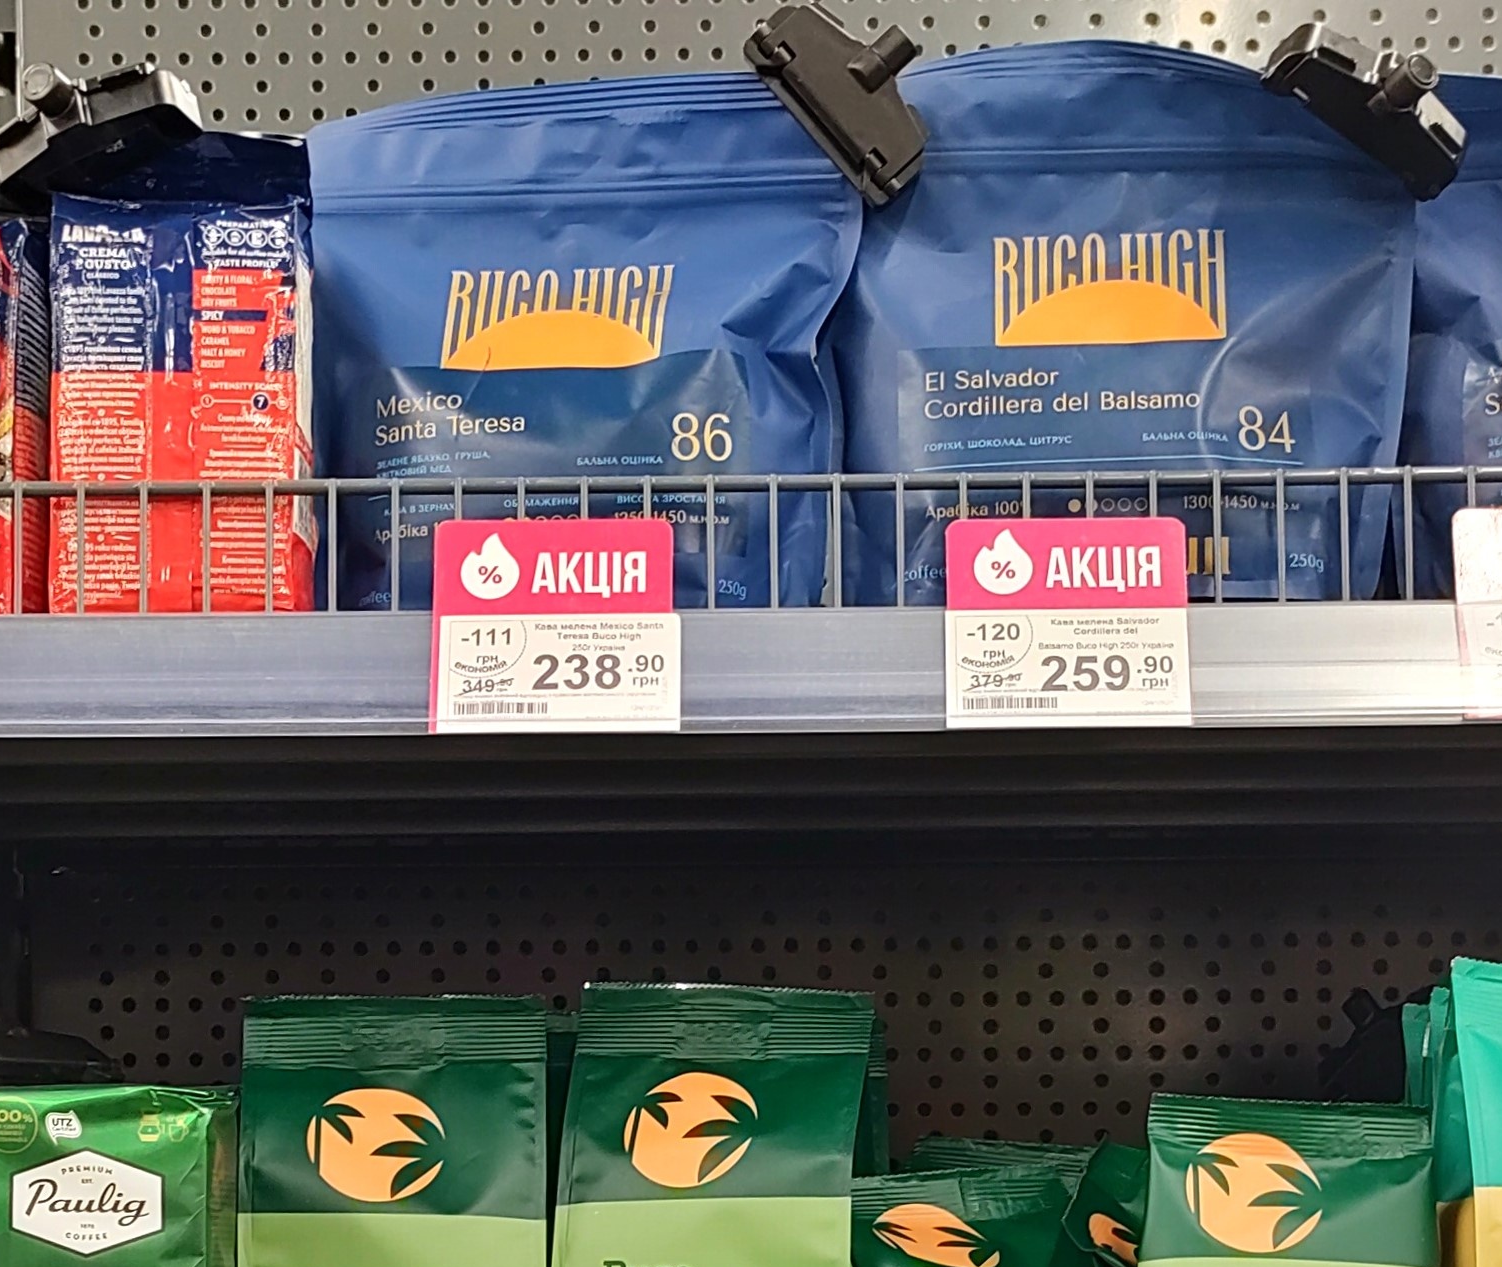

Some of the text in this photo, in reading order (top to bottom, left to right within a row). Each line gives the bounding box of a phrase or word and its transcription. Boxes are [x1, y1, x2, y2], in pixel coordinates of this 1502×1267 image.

[993, 228, 1226, 344] BUCO HIGH
[442, 265, 674, 368] BUCO HIGH
[925, 367, 1059, 392] El Salvador
[376, 392, 463, 419] Mexico
[925, 390, 1200, 419] Cordillera del Balsamo
[375, 413, 525, 446] Santa Teresa
[672, 412, 733, 461] 86
[1237, 406, 1296, 453] 84
[532, 552, 647, 594] АКЦІЯ
[1046, 547, 1161, 592] АКЦІЯ
[1290, 554, 1323, 573] 250g
[462, 628, 511, 646] -111
[967, 623, 1020, 641] -120
[532, 654, 621, 690] 238
[1041, 655, 1130, 691] 259
[1142, 678, 1169, 689] грн
[26, 1178, 151, 1226] Paulig
